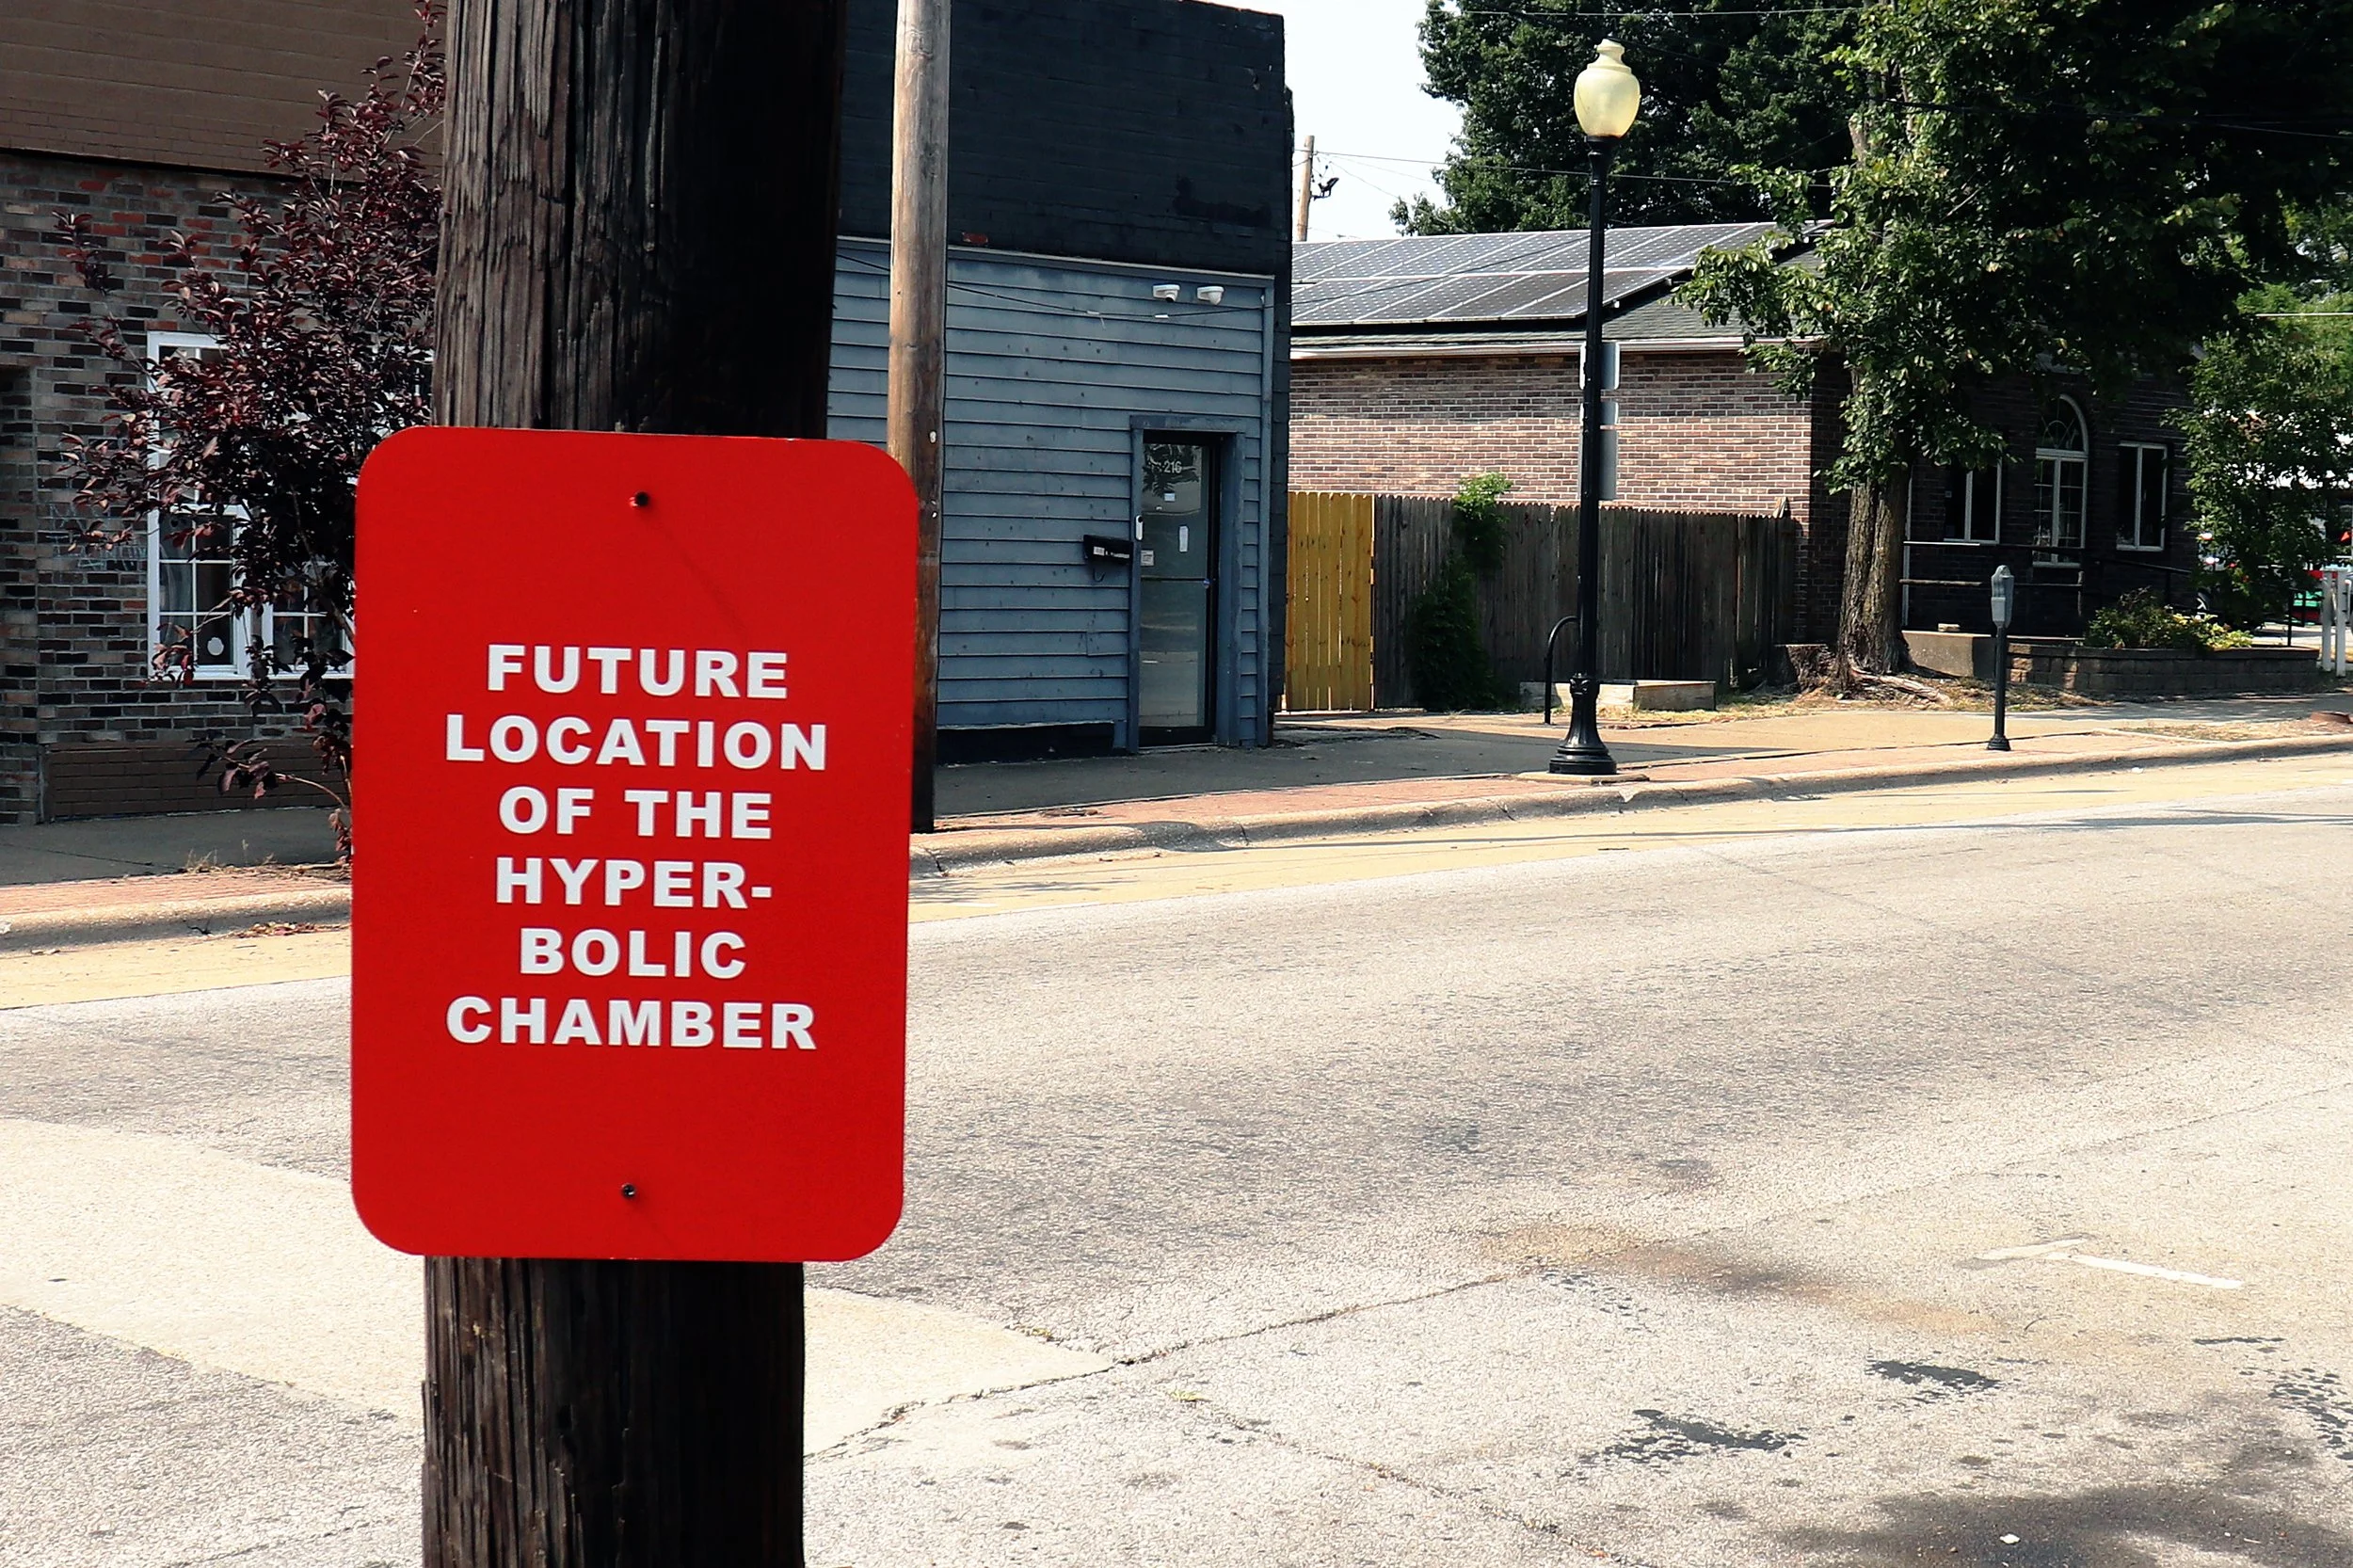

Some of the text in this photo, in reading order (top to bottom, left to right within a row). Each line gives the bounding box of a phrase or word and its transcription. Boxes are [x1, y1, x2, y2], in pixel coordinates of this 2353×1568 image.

[1163, 460, 1182, 473] 216
[488, 644, 788, 699] FUTURE
[446, 713, 826, 771] LOCATION
[499, 786, 772, 840] OF THE
[496, 856, 772, 909] HYPER-
[520, 927, 746, 980] BOLIC
[446, 996, 817, 1050] CHAMBER
